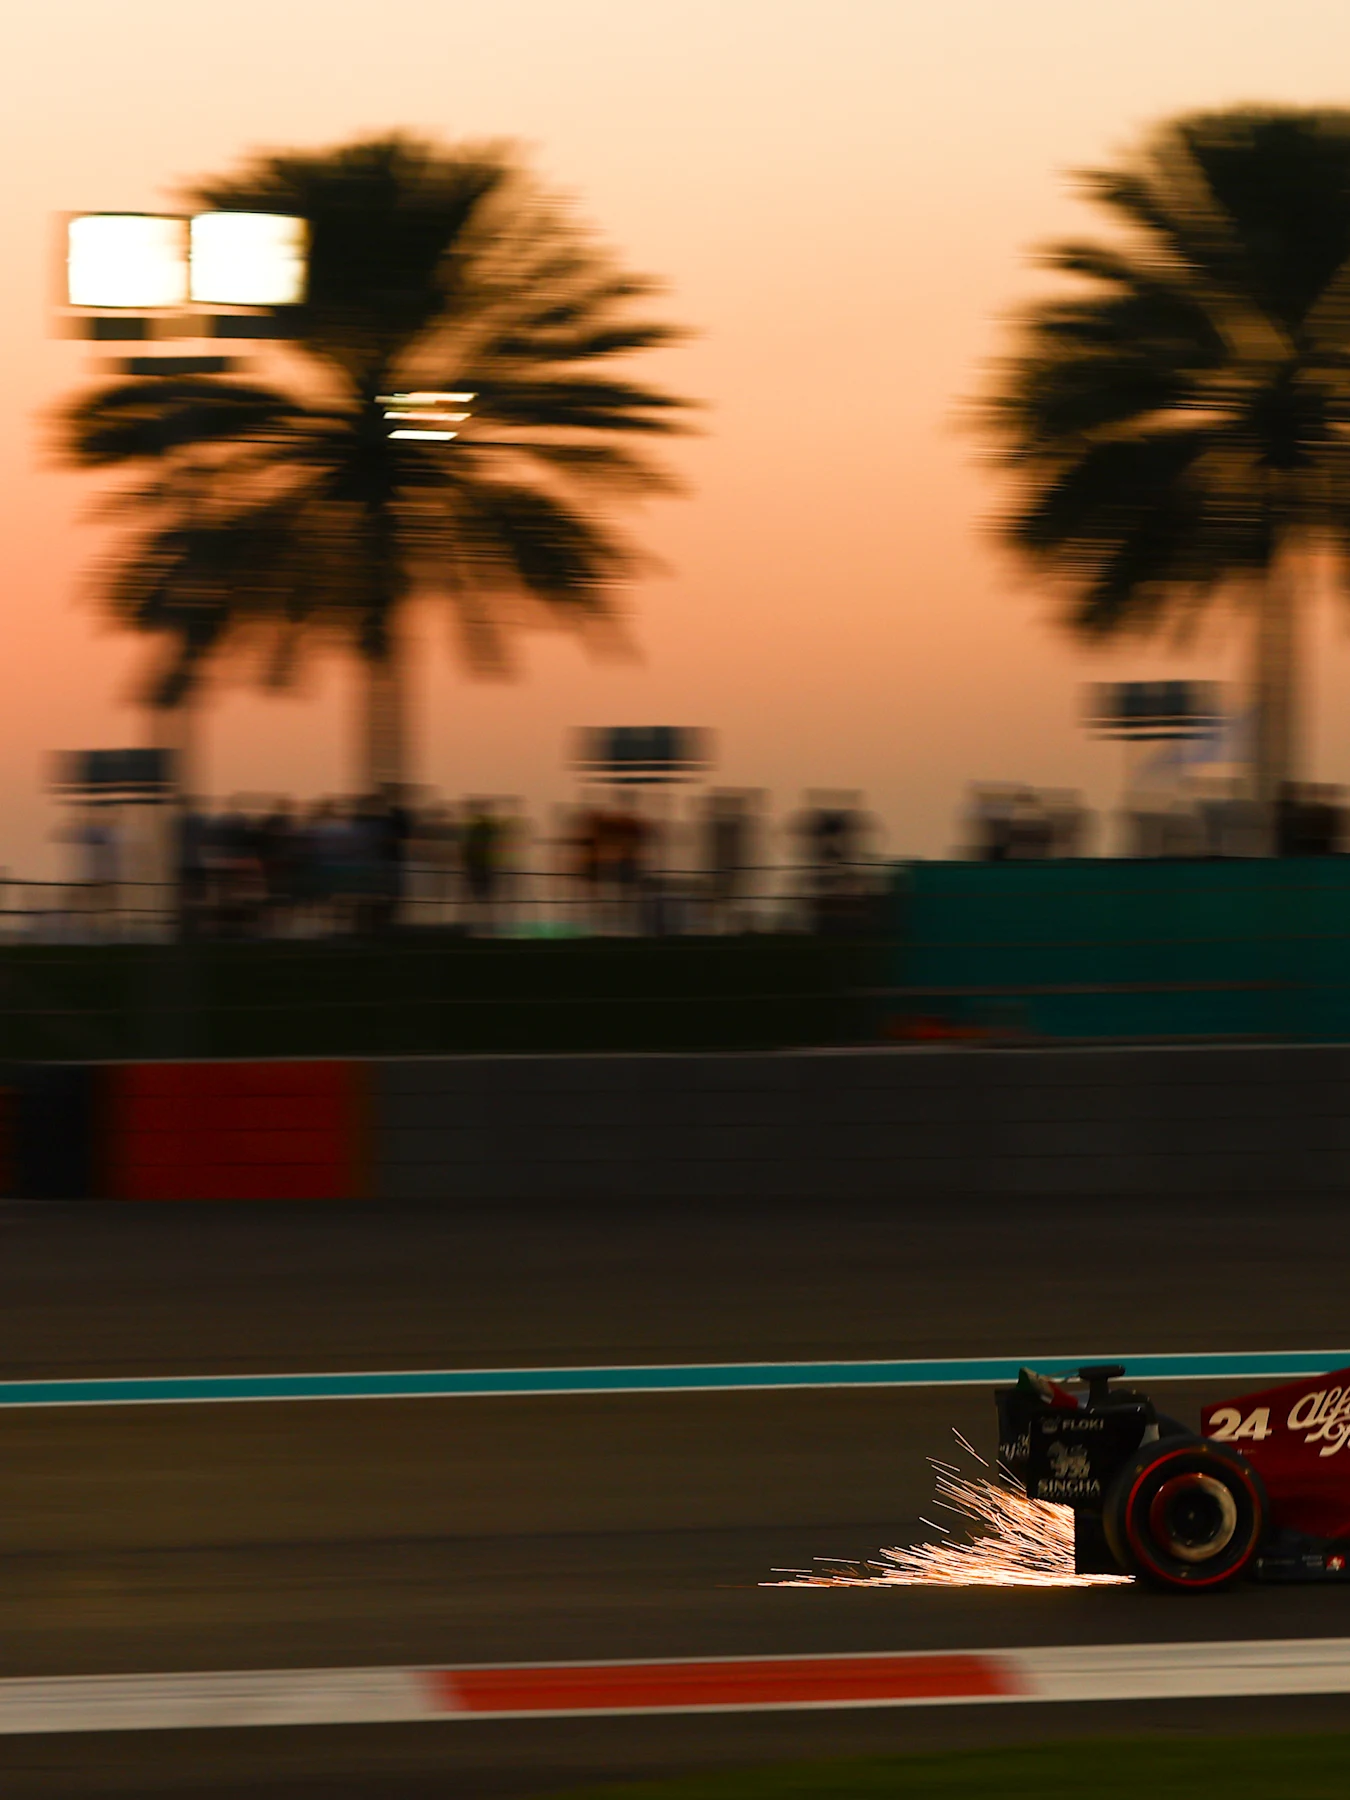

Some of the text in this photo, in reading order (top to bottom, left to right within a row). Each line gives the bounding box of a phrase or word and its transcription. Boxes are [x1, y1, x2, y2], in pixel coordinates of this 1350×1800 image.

[1062, 1418, 1104, 1431] FLOKI
[1208, 1407, 1273, 1442] 24
[1038, 1479, 1100, 1495] SINGHA
